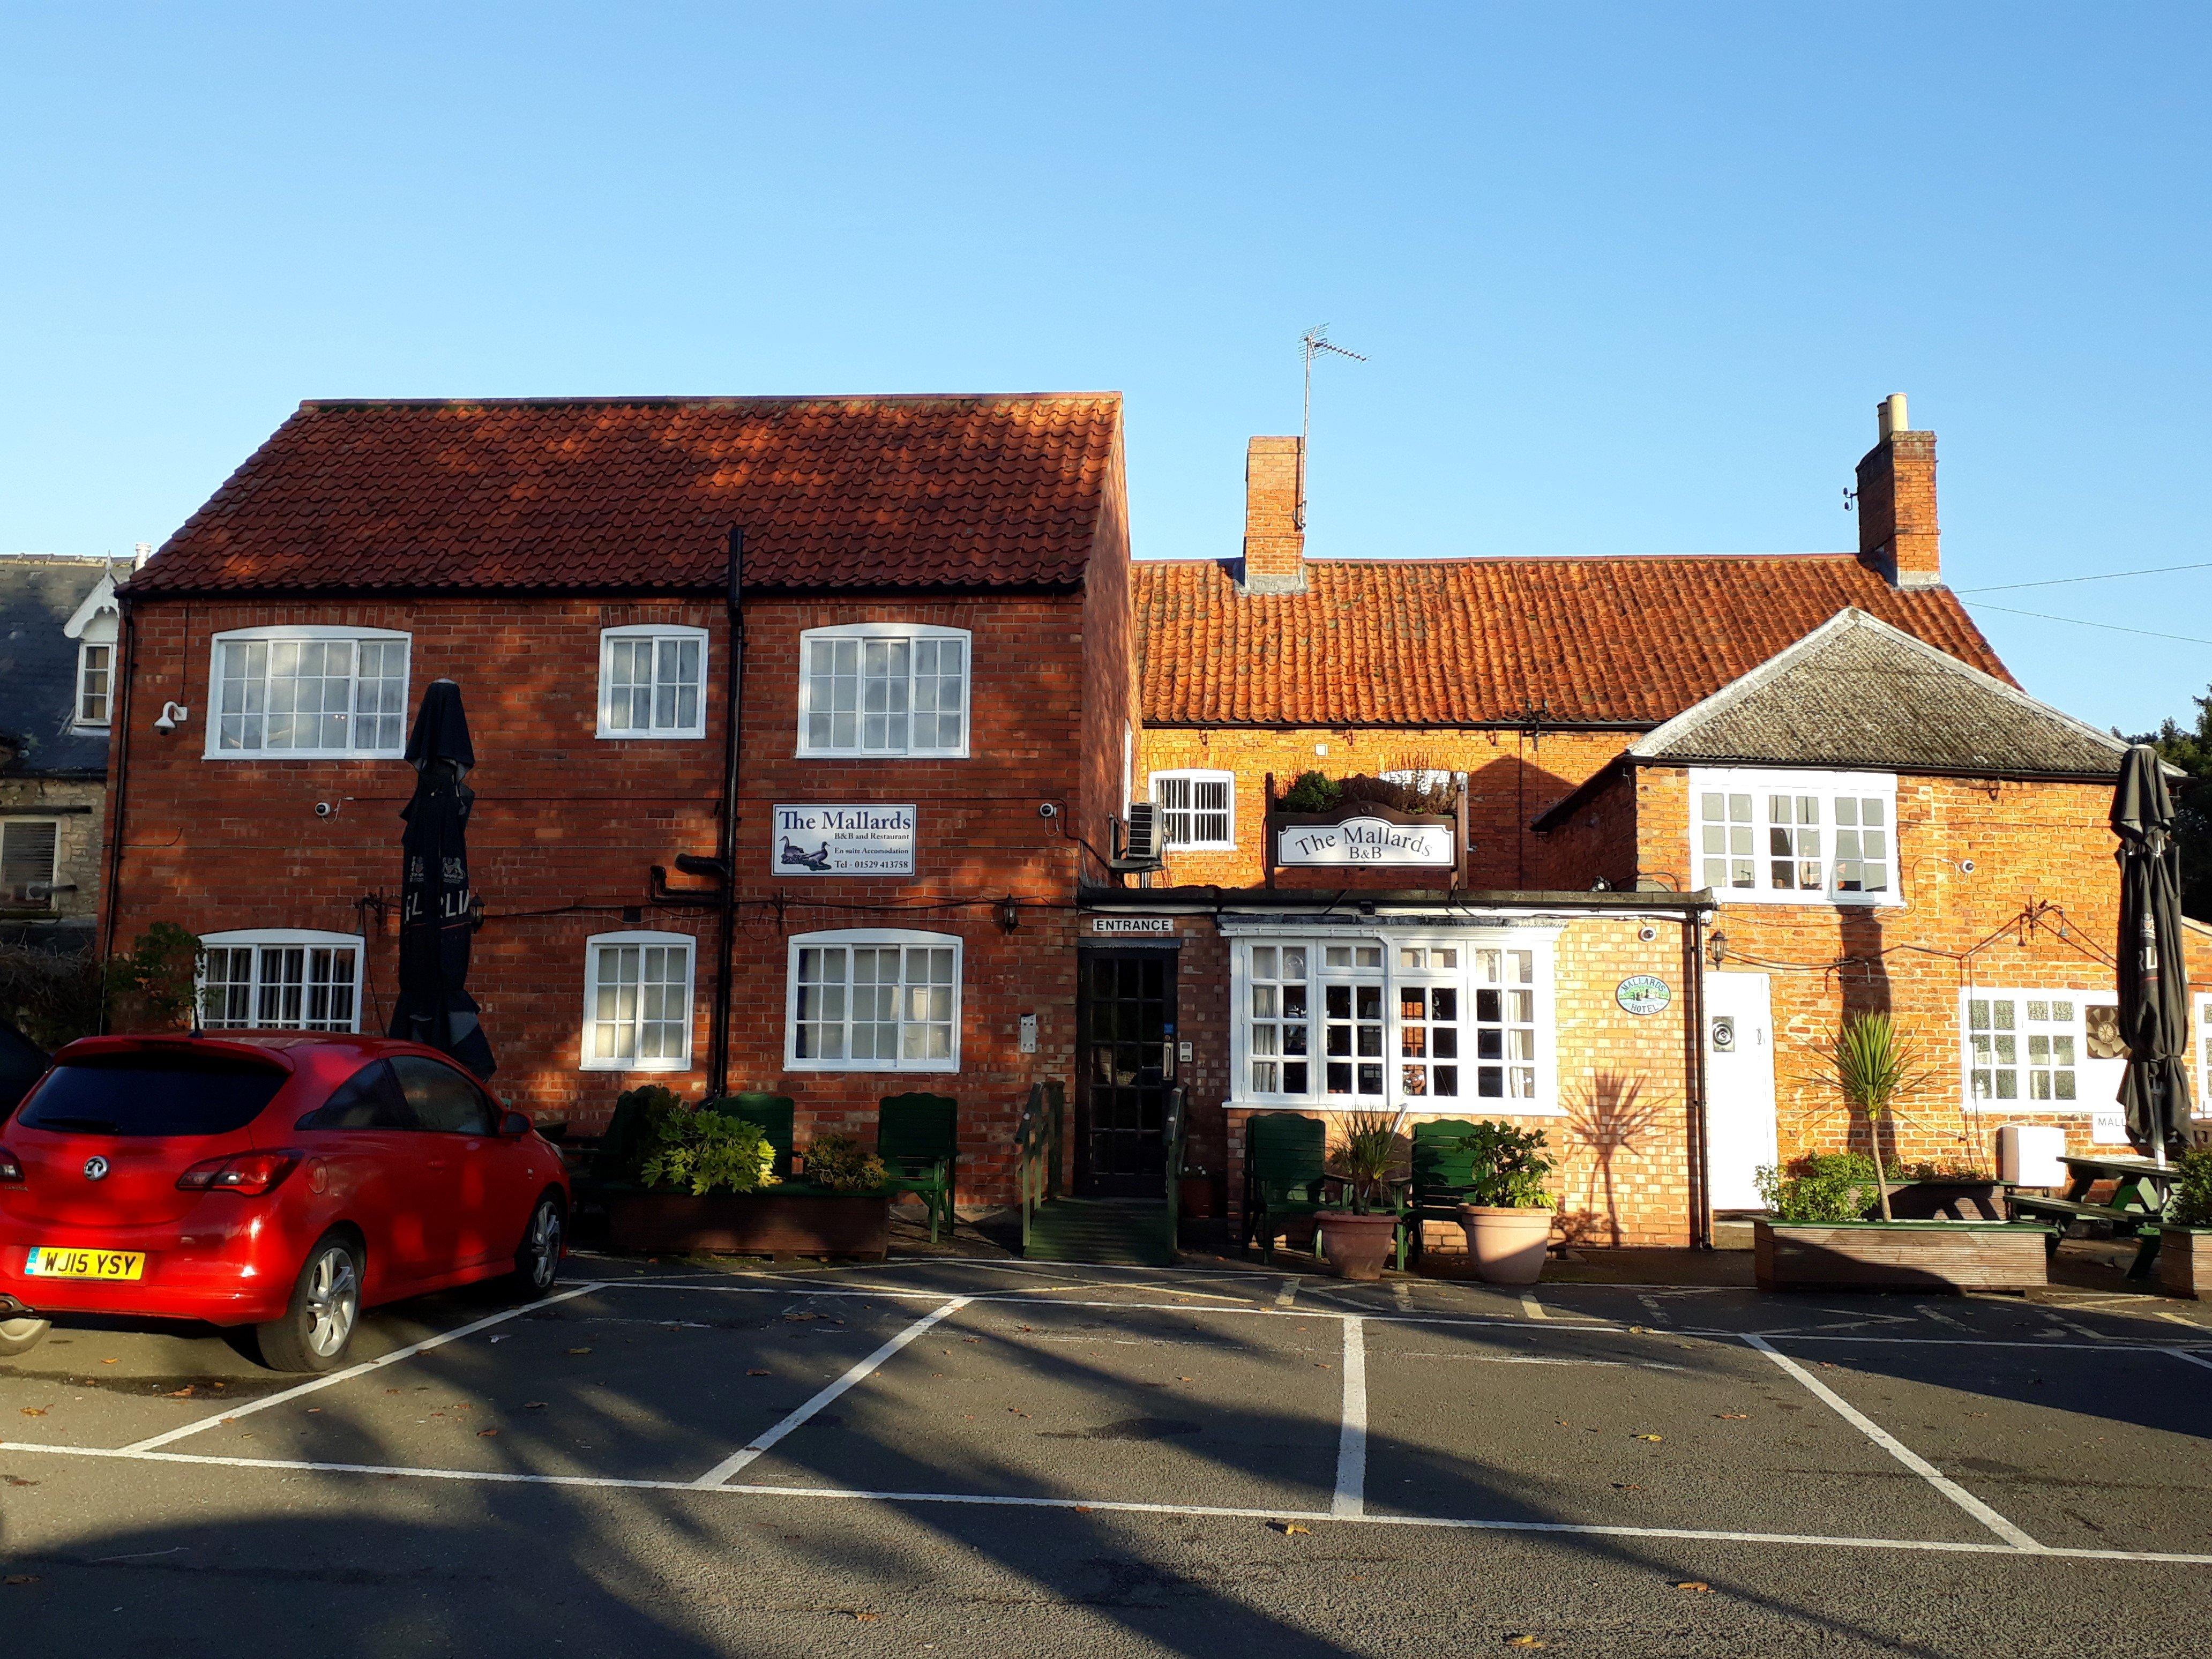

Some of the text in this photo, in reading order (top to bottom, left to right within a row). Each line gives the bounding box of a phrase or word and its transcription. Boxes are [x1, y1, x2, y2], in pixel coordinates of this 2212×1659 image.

[779, 810, 911, 829] The Mallards
[1295, 826, 1432, 857] The Mallards
[1349, 846, 1382, 859] B&B
[834, 860, 847, 868] Tel
[1096, 920, 1170, 930] ENTRANCE
[1621, 977, 1666, 992] MALLARDS
[1630, 1003, 1659, 1013] HOTEL
[97, 1254, 137, 1275] YSY
